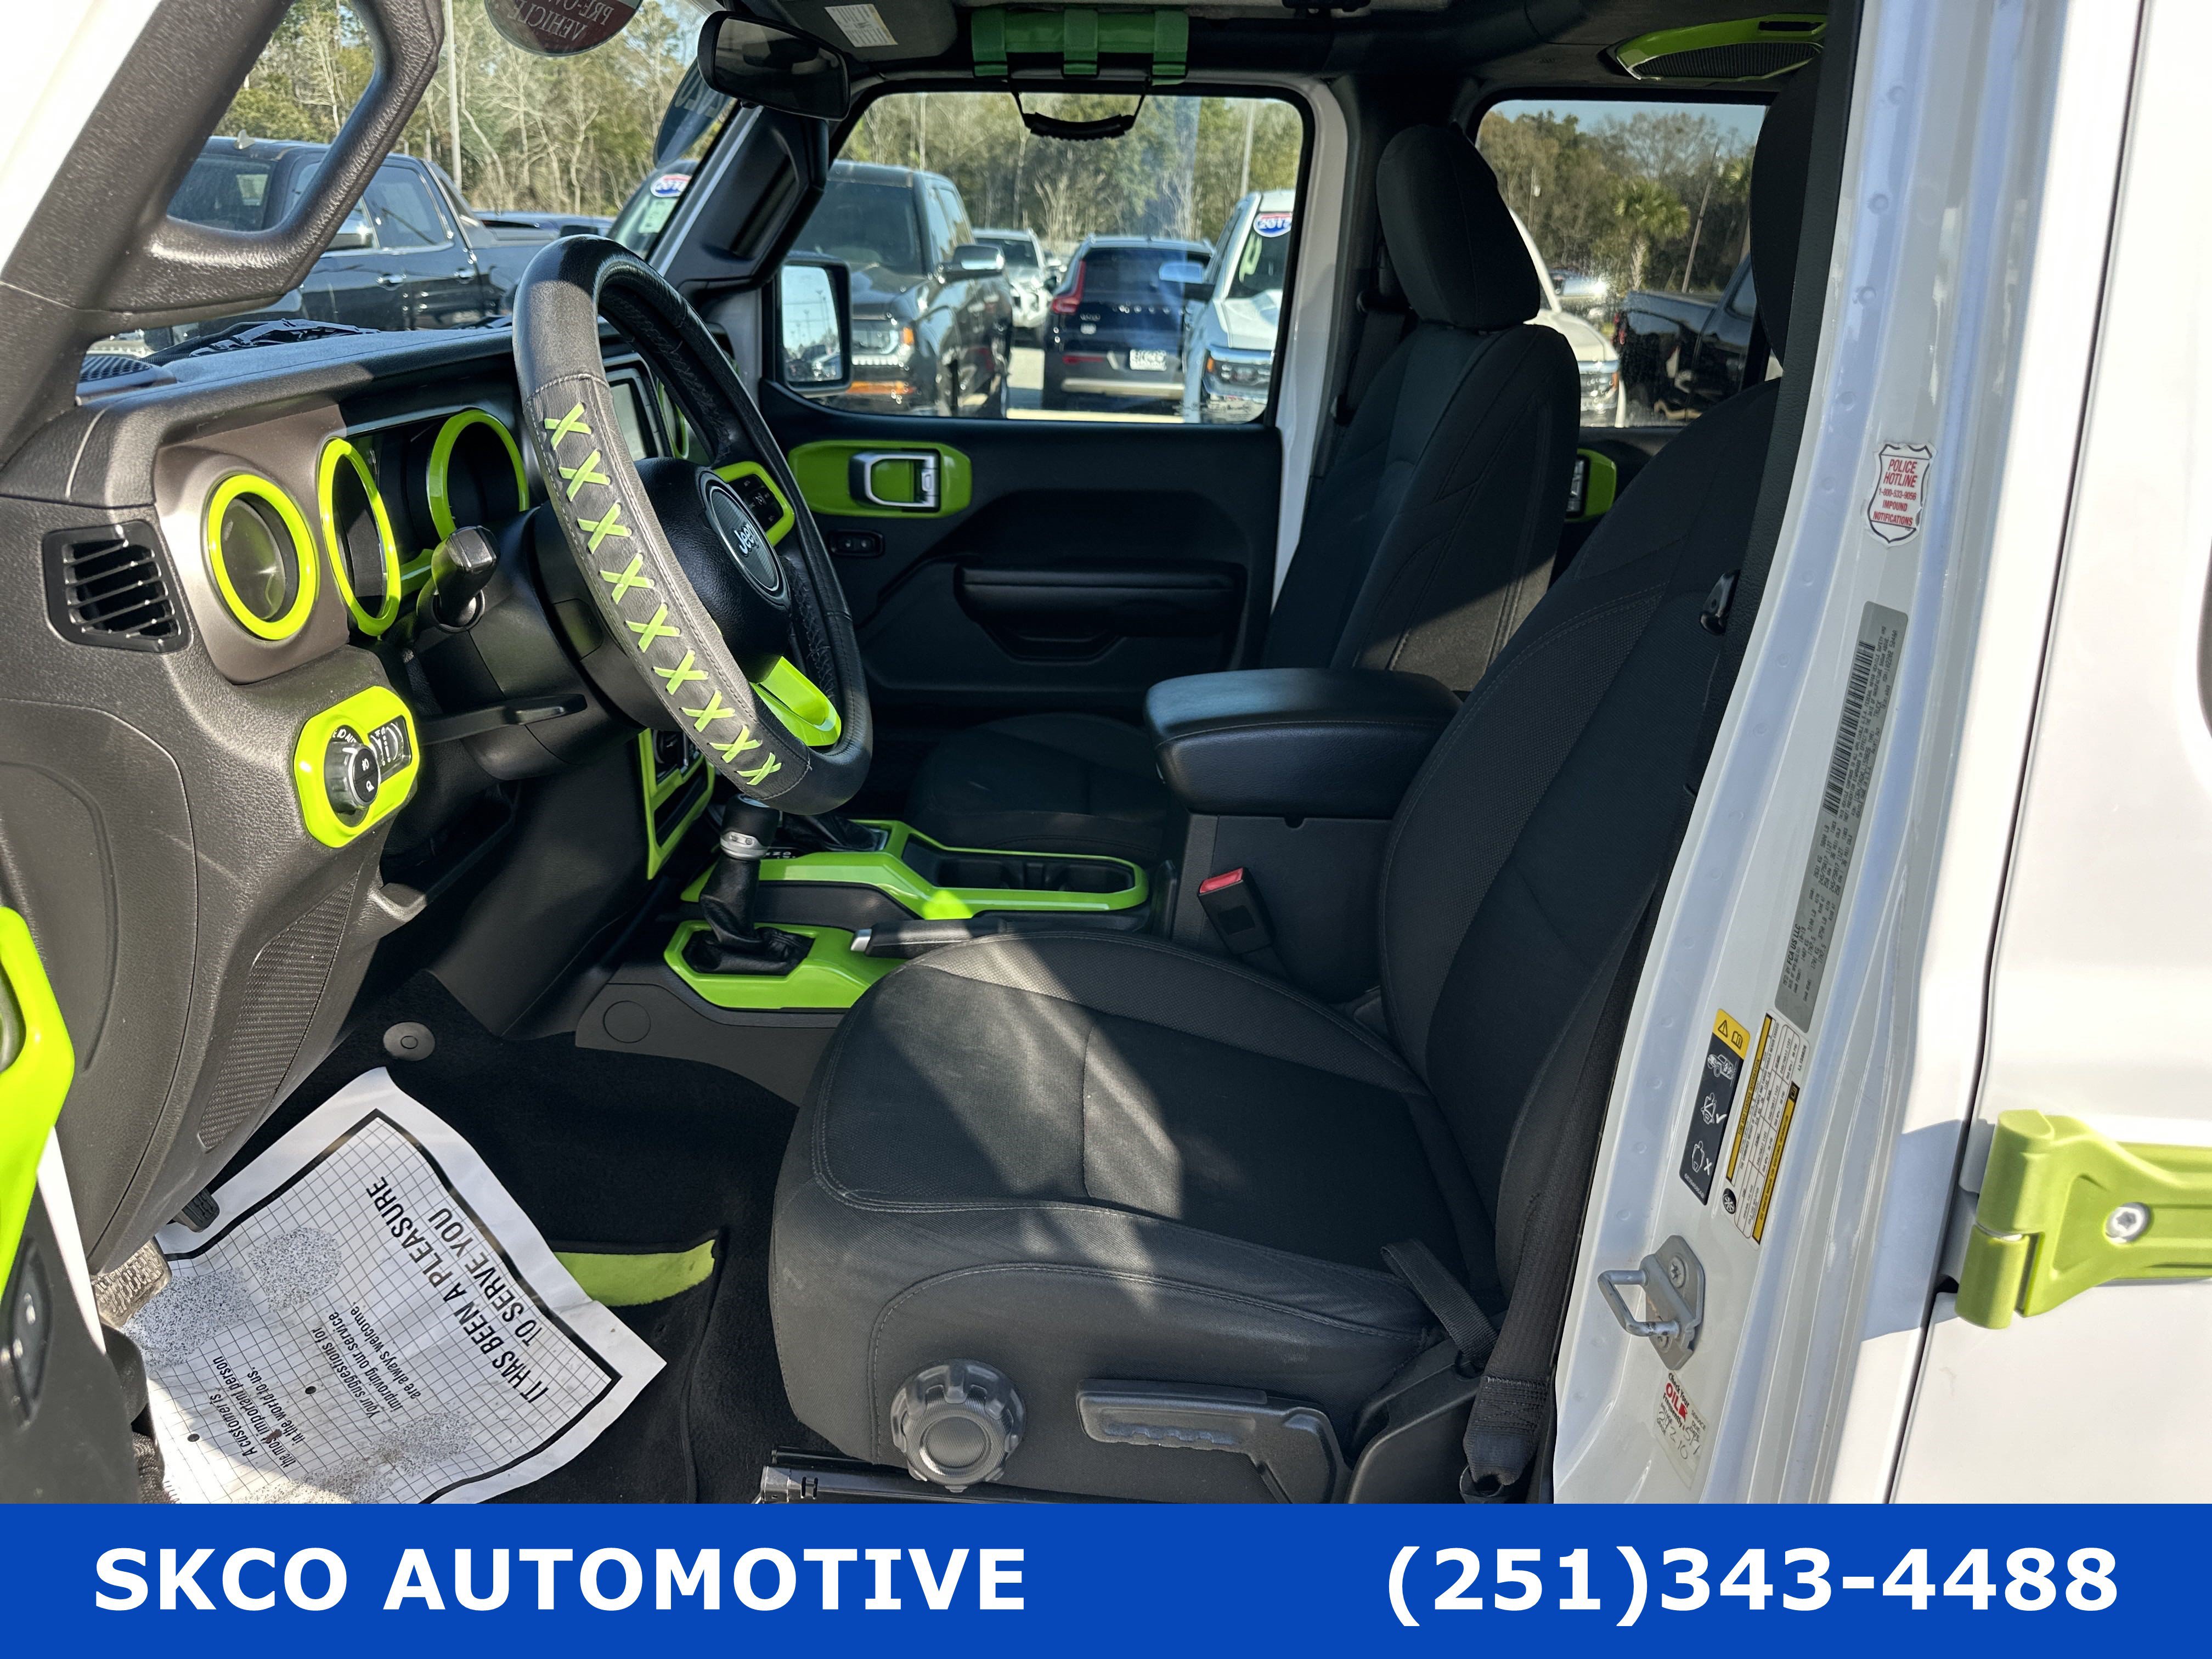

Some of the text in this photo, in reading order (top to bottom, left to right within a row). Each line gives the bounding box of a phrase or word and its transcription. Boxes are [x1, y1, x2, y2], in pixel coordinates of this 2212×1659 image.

[1883, 472, 1917, 488] HOTLINE
[1888, 459, 1917, 474] POLICE
[1873, 511, 1913, 526] NOTIFICATIONS
[1882, 500, 1908, 511] IMPOUND
[734, 523, 758, 555] Jeep
[1786, 949, 1795, 966] FCA
[1790, 938, 1797, 950] US
[1749, 1057, 1759, 1092] INFORMATION
[364, 1176, 549, 1403] IT HAS BEEN A PLEASURE
[427, 1205, 541, 1346] TO SERVE YOU
[328, 1311, 403, 1413] improving our service
[349, 1301, 421, 1399] are always welcome.
[211, 1356, 242, 1391] person
[311, 1325, 380, 1418] Your suggestions for
[248, 1366, 306, 1445] in the world to us.
[1666, 1383, 1679, 1412] OIL
[1668, 1373, 1690, 1407] Check Your
[210, 1393, 257, 1455] A customer is
[230, 1389, 270, 1436] important
[1691, 1409, 1707, 1431] SERVICE
[1691, 1422, 1701, 1434] DUE
[278, 1453, 296, 1468] the
